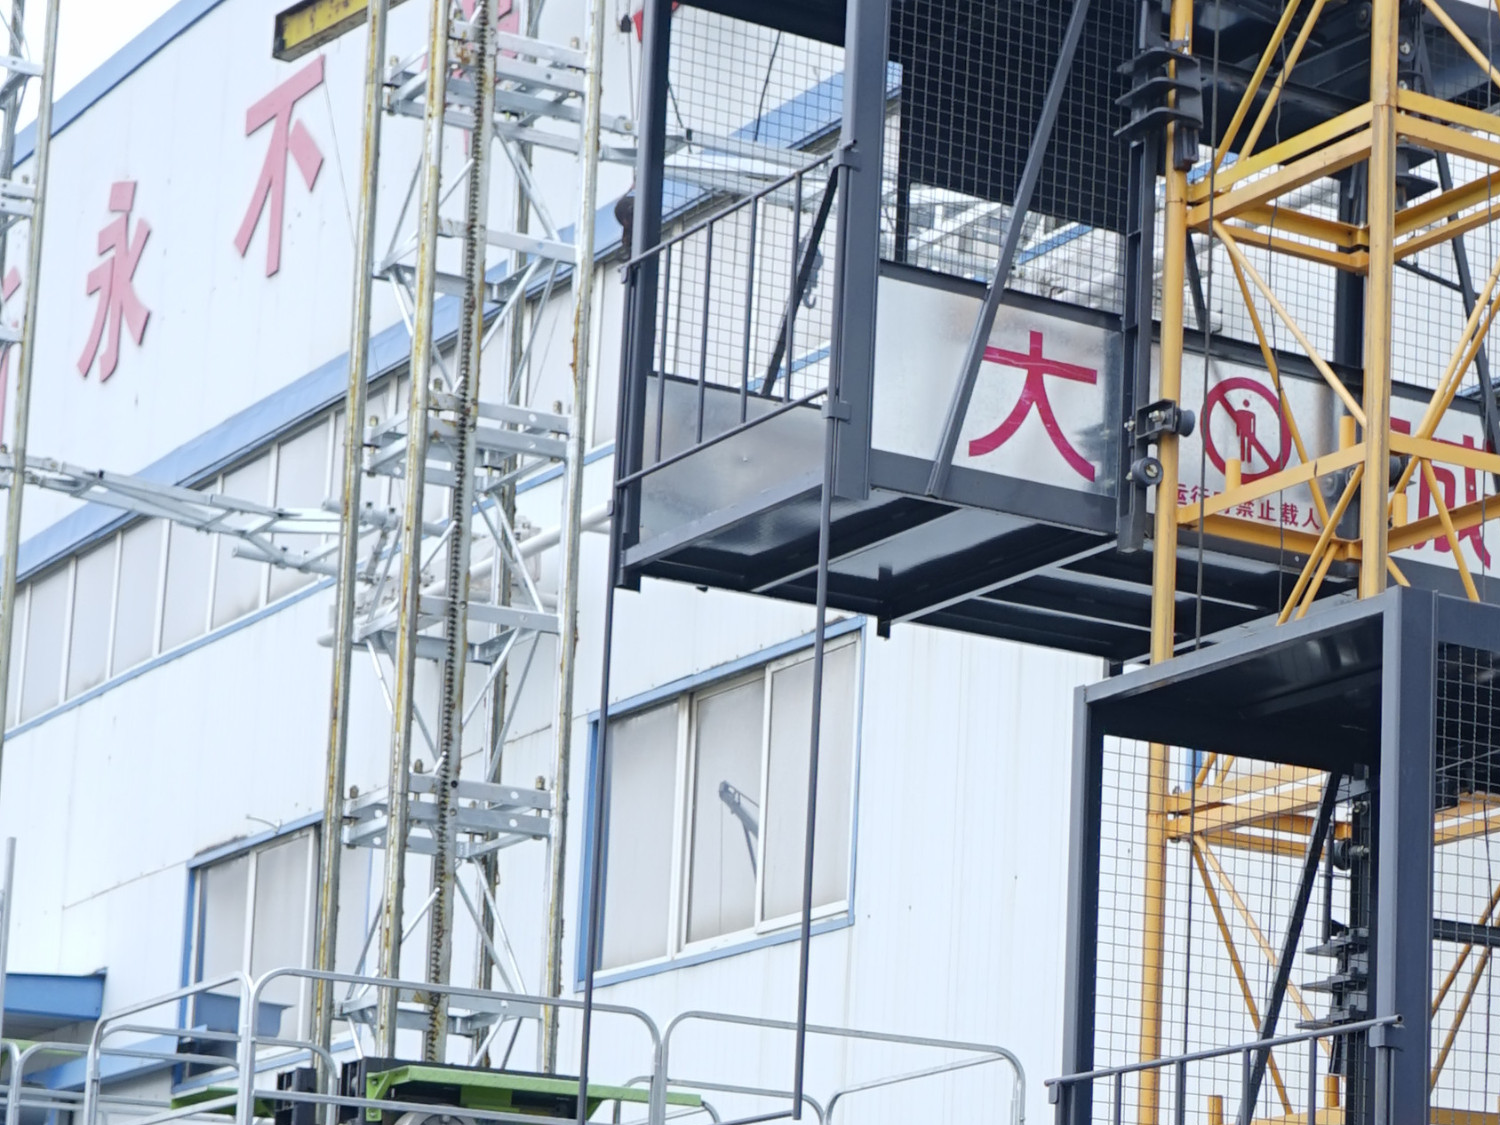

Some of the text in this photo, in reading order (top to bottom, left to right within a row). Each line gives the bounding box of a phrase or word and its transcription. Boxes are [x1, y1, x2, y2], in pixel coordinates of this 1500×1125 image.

[76, 179, 153, 383] 永
[233, 55, 326, 278] 不
[968, 329, 1098, 483] 大
[1177, 482, 1321, 531] 运行禁止载人
